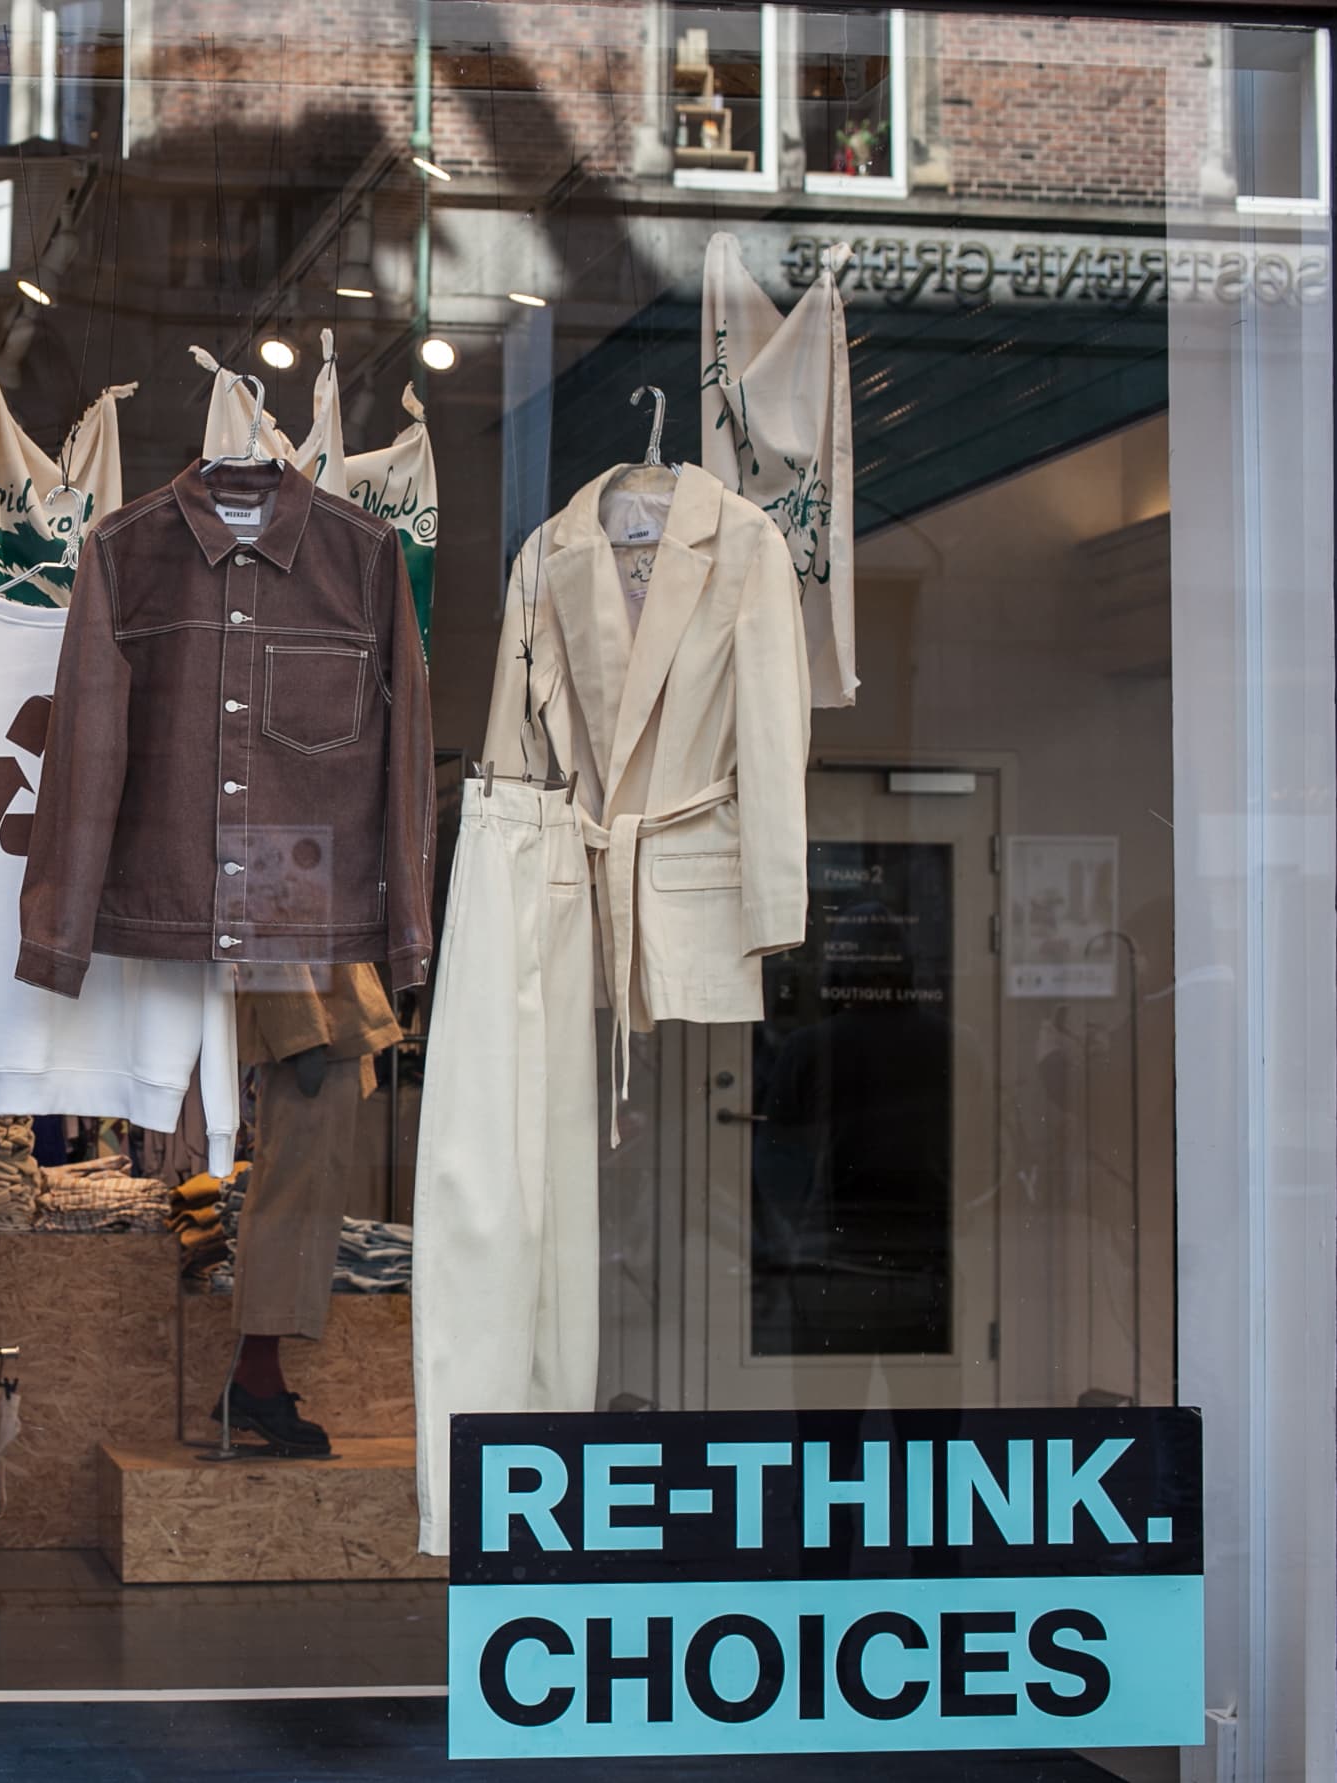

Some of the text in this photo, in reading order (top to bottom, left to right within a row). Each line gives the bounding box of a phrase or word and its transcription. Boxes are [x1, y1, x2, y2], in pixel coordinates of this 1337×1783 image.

[820, 986, 892, 1001] BOUTIQUE
[897, 988, 944, 1002] LIVING
[482, 1439, 1172, 1552] RE-THINK.
[480, 1609, 1110, 1727] CHOICES
